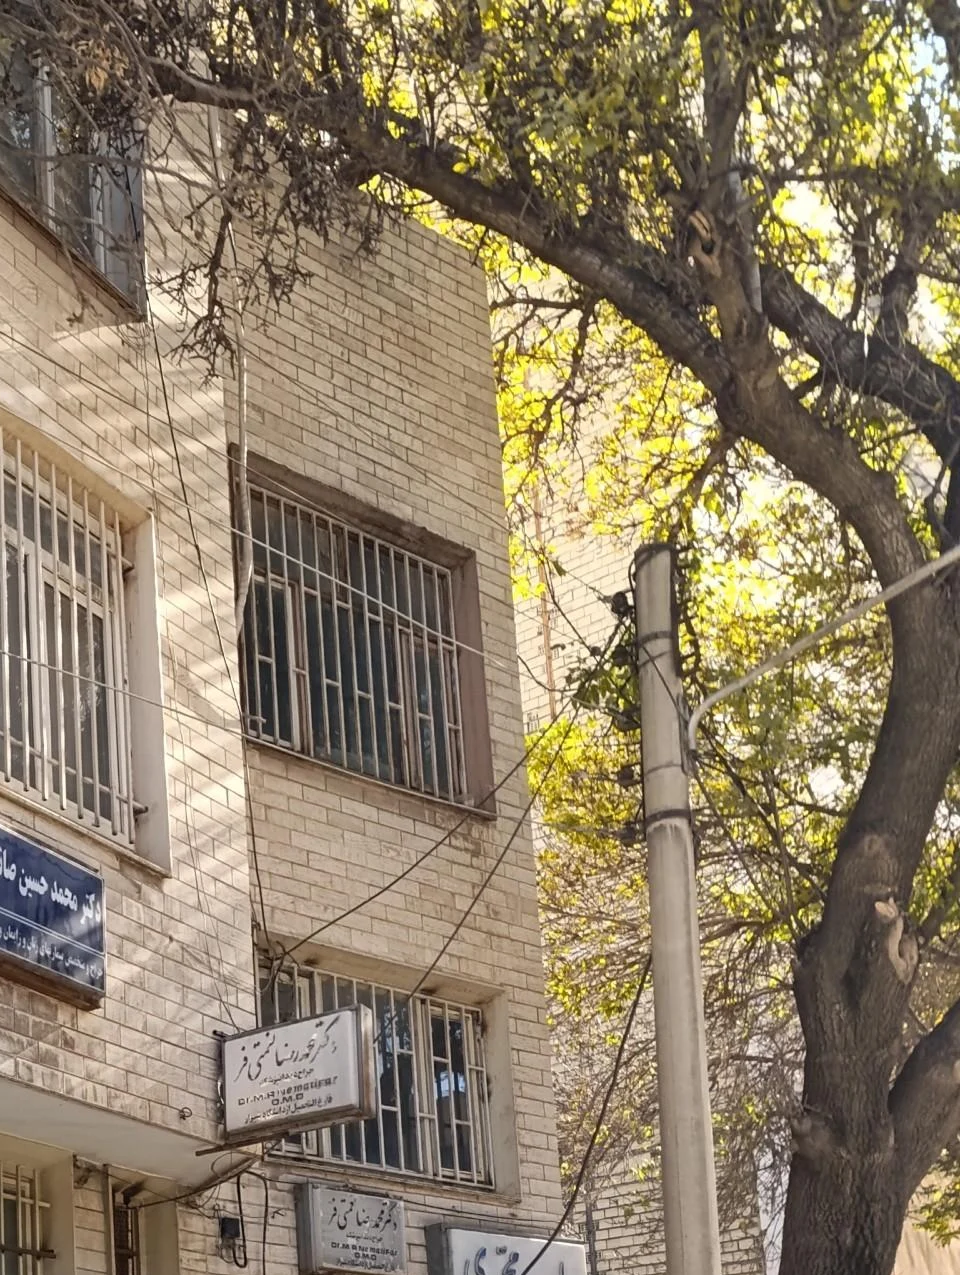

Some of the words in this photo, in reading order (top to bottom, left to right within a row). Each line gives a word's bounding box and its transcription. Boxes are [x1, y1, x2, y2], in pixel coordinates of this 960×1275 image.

[18, 868, 49, 897] حسین
[50, 880, 78, 912] محمد
[80, 893, 102, 925] دکتر
[310, 1015, 340, 1064] دکتر
